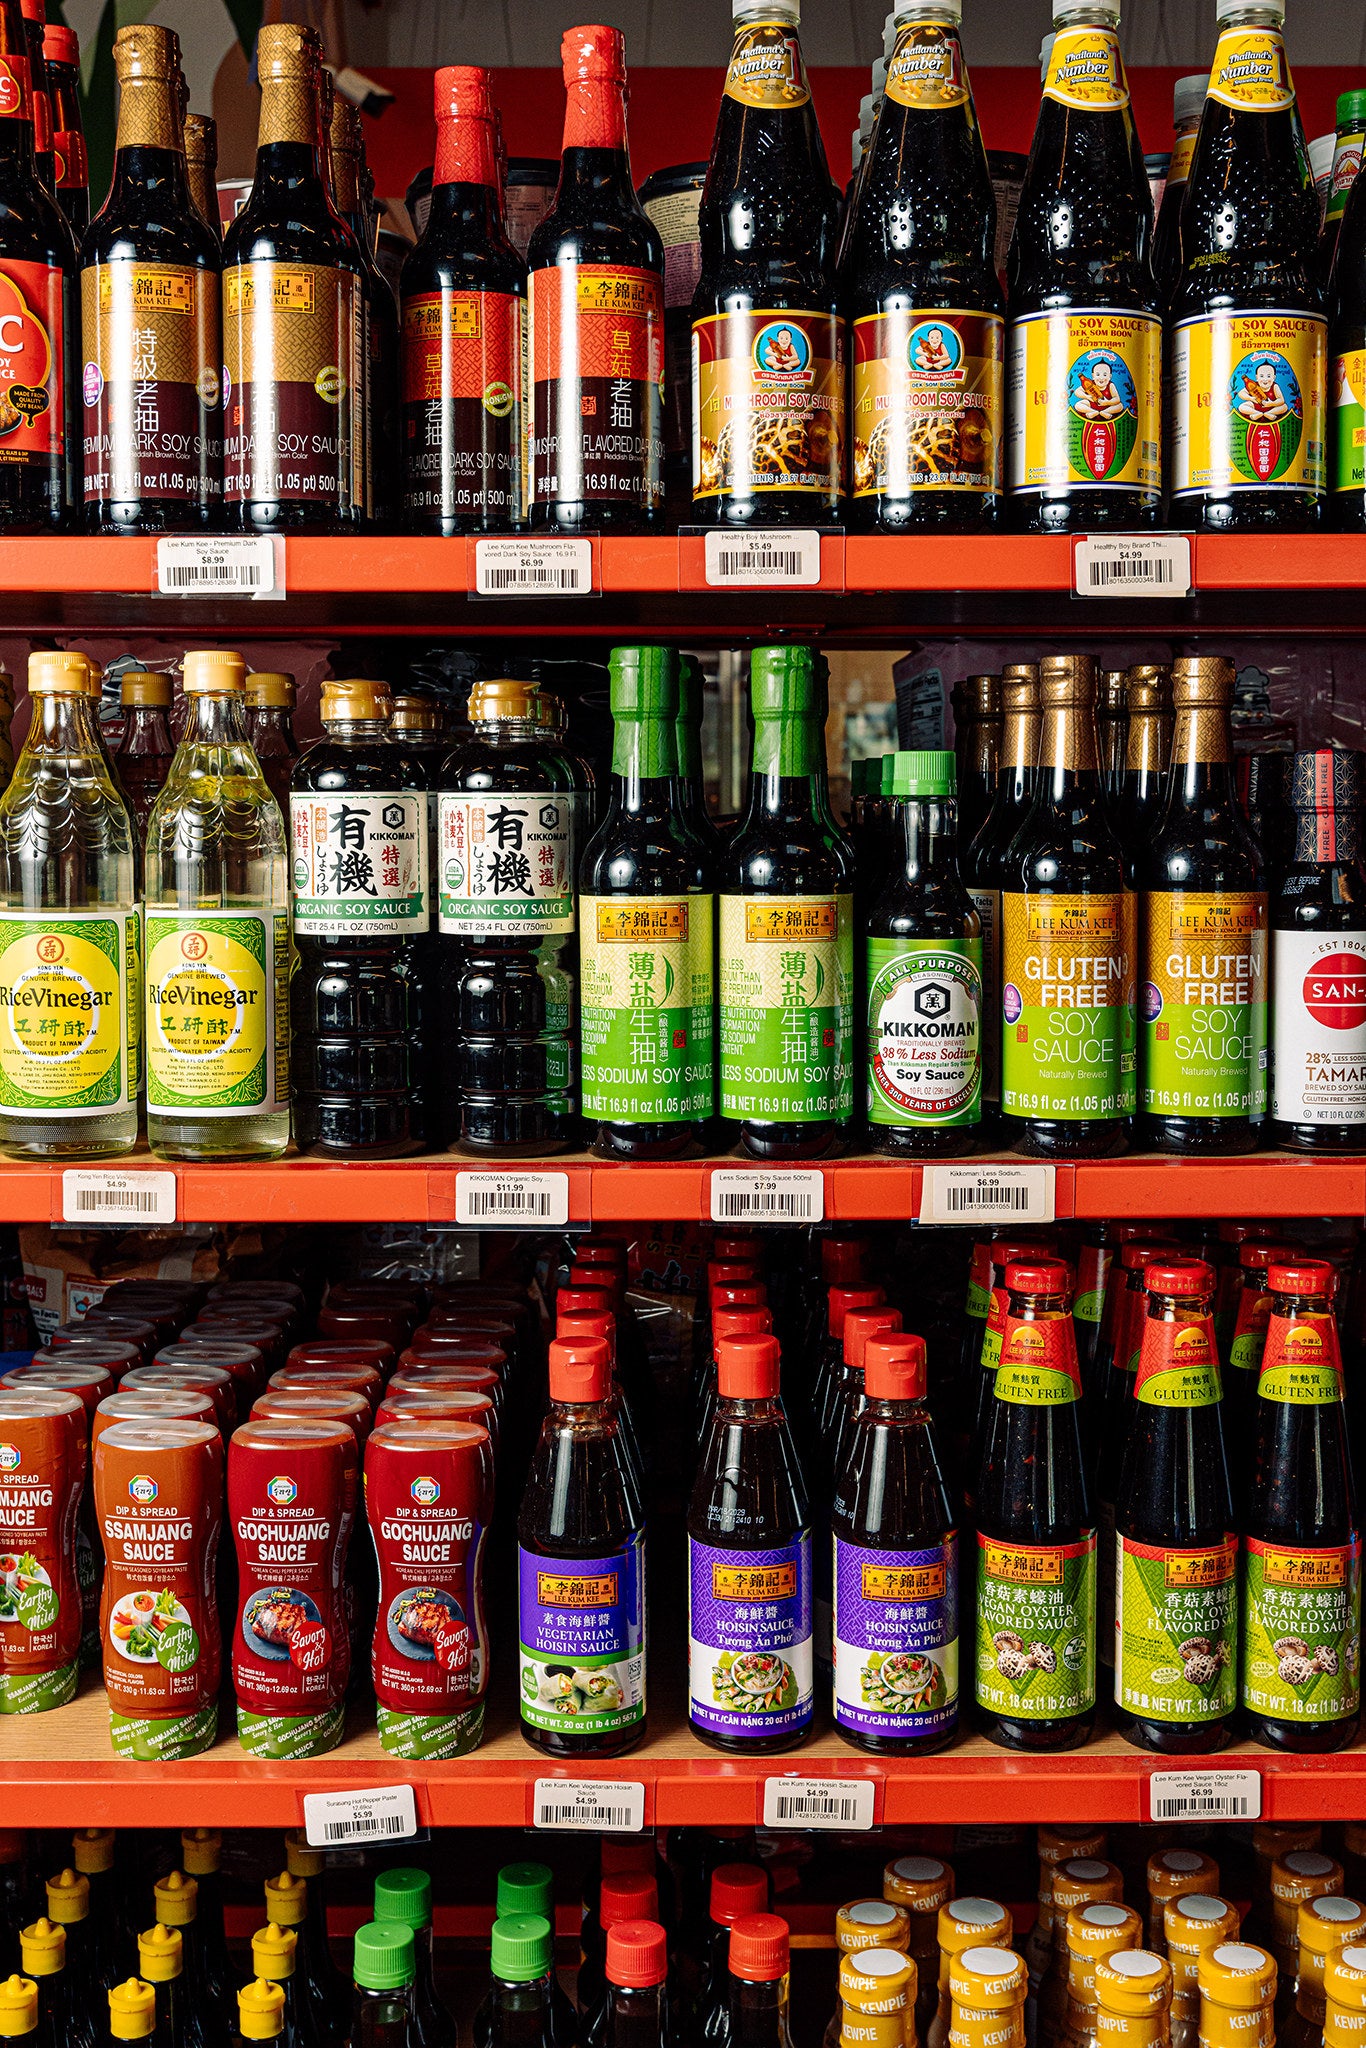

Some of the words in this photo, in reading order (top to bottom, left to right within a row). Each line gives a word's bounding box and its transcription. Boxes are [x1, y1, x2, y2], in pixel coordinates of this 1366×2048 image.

[740, 44, 785, 60] Thailand's
[730, 57, 785, 81] Number
[890, 57, 945, 81] Number
[1055, 61, 1109, 83] Number
[1219, 62, 1273, 84] Number
[597, 281, 646, 300] 李錦記
[595, 299, 609, 308] LEE
[611, 300, 627, 309] KUM
[629, 301, 645, 310] KEE
[1080, 318, 1104, 328] SOY
[1110, 320, 1142, 331] SAUCE
[1070, 329, 1087, 337] DEK
[1090, 329, 1109, 337] SOM
[133, 328, 159, 432] 特級老抽
[610, 330, 632, 428] 草菇老抽
[31, 391, 45, 399] FROM
[939, 392, 961, 406] SOY
[964, 392, 992, 408] SAUCE
[16, 402, 27, 410] SOY
[585, 475, 607, 491] 16.9
[619, 478, 630, 492] oz
[243, 539, 257, 547] Dark
[760, 533, 792, 541] Mushroom
[197, 548, 208, 556] Soy
[210, 547, 229, 555] Sauce
[1119, 542, 1130, 550] Boy
[202, 556, 224, 564] $8.99
[1120, 551, 1142, 559] $4.99
[370, 832, 415, 841] KIKKOMAN
[329, 803, 378, 897] 有機
[486, 804, 536, 897] 有機
[316, 846, 329, 895] しょうゆ
[381, 845, 401, 887] 特選
[296, 903, 342, 916] ORGANIC
[345, 903, 370, 916] SOY
[374, 903, 411, 914] SAUCE
[304, 922, 317, 930] NET
[319, 923, 335, 931] 25.4
[337, 923, 348, 931] FL
[350, 923, 363, 931] OZ
[366, 922, 399, 931] (750mL)
[615, 912, 668, 928] 李錦記
[615, 928, 628, 936] LEE
[630, 928, 651, 937] KUM
[653, 928, 667, 936] KEE
[1319, 941, 1338, 952] EST
[889, 960, 973, 981] ALL-PURPOSE
[1024, 957, 1122, 980] GLUTEN
[1165, 955, 1262, 978] GLUTEN
[149, 984, 258, 1009] RiceVinegar
[1041, 985, 1107, 1008] FREE
[1184, 983, 1248, 1004] FREE
[1312, 983, 1366, 998] SAN-
[0, 987, 113, 1010] RiceVinegar
[1048, 1012, 1101, 1035] SOY
[1192, 1010, 1242, 1033] SOY
[883, 1022, 975, 1037] KIKKOMAN
[883, 1047, 895, 1059] 38
[911, 1048, 937, 1060] Less
[940, 1048, 976, 1060] Sodium
[1033, 1038, 1113, 1063] SAUCE
[1175, 1036, 1253, 1061] SAUCE
[1306, 1053, 1331, 1064] 28%
[597, 1068, 648, 1084] SODIUM
[652, 1067, 681, 1083] SOY
[896, 1069, 921, 1082] Soy
[925, 1070, 965, 1080] Sauce
[1039, 1069, 1075, 1079] Naturally
[1078, 1069, 1107, 1079] Brewed
[107, 1180, 126, 1188] $4.99
[531, 1175, 543, 1183] Soy
[760, 1174, 771, 1182] Soy
[1154, 1387, 1203, 1400] GLUTEN
[1265, 1384, 1314, 1397] GLUTEN
[116, 1506, 129, 1516] DIP
[131, 1508, 138, 1516] &
[140, 1507, 178, 1517] SPREAD
[105, 1522, 192, 1541] SSAMJANG
[238, 1522, 330, 1541] GOCHUJANG
[124, 1543, 174, 1561] SAUCE
[259, 1544, 306, 1561] SAUCE
[555, 1582, 600, 1596] 李錦記
[1154, 1606, 1203, 1621] VEGAN
[716, 1620, 758, 1632] HOISIN
[760, 1618, 794, 1632] SAUCE
[1148, 1618, 1219, 1633] FLAVORED
[537, 1627, 614, 1640] VEGETARIAN
[536, 1639, 578, 1653] HOISIN
[581, 1639, 620, 1652] SAUCE
[173, 1675, 195, 1685] 한국산
[173, 1686, 195, 1694] KOREA
[1274, 1883, 1312, 1899] KEWPIE
[840, 1933, 880, 1947] KEWPIE
[859, 1993, 907, 2015] KEWPIE
